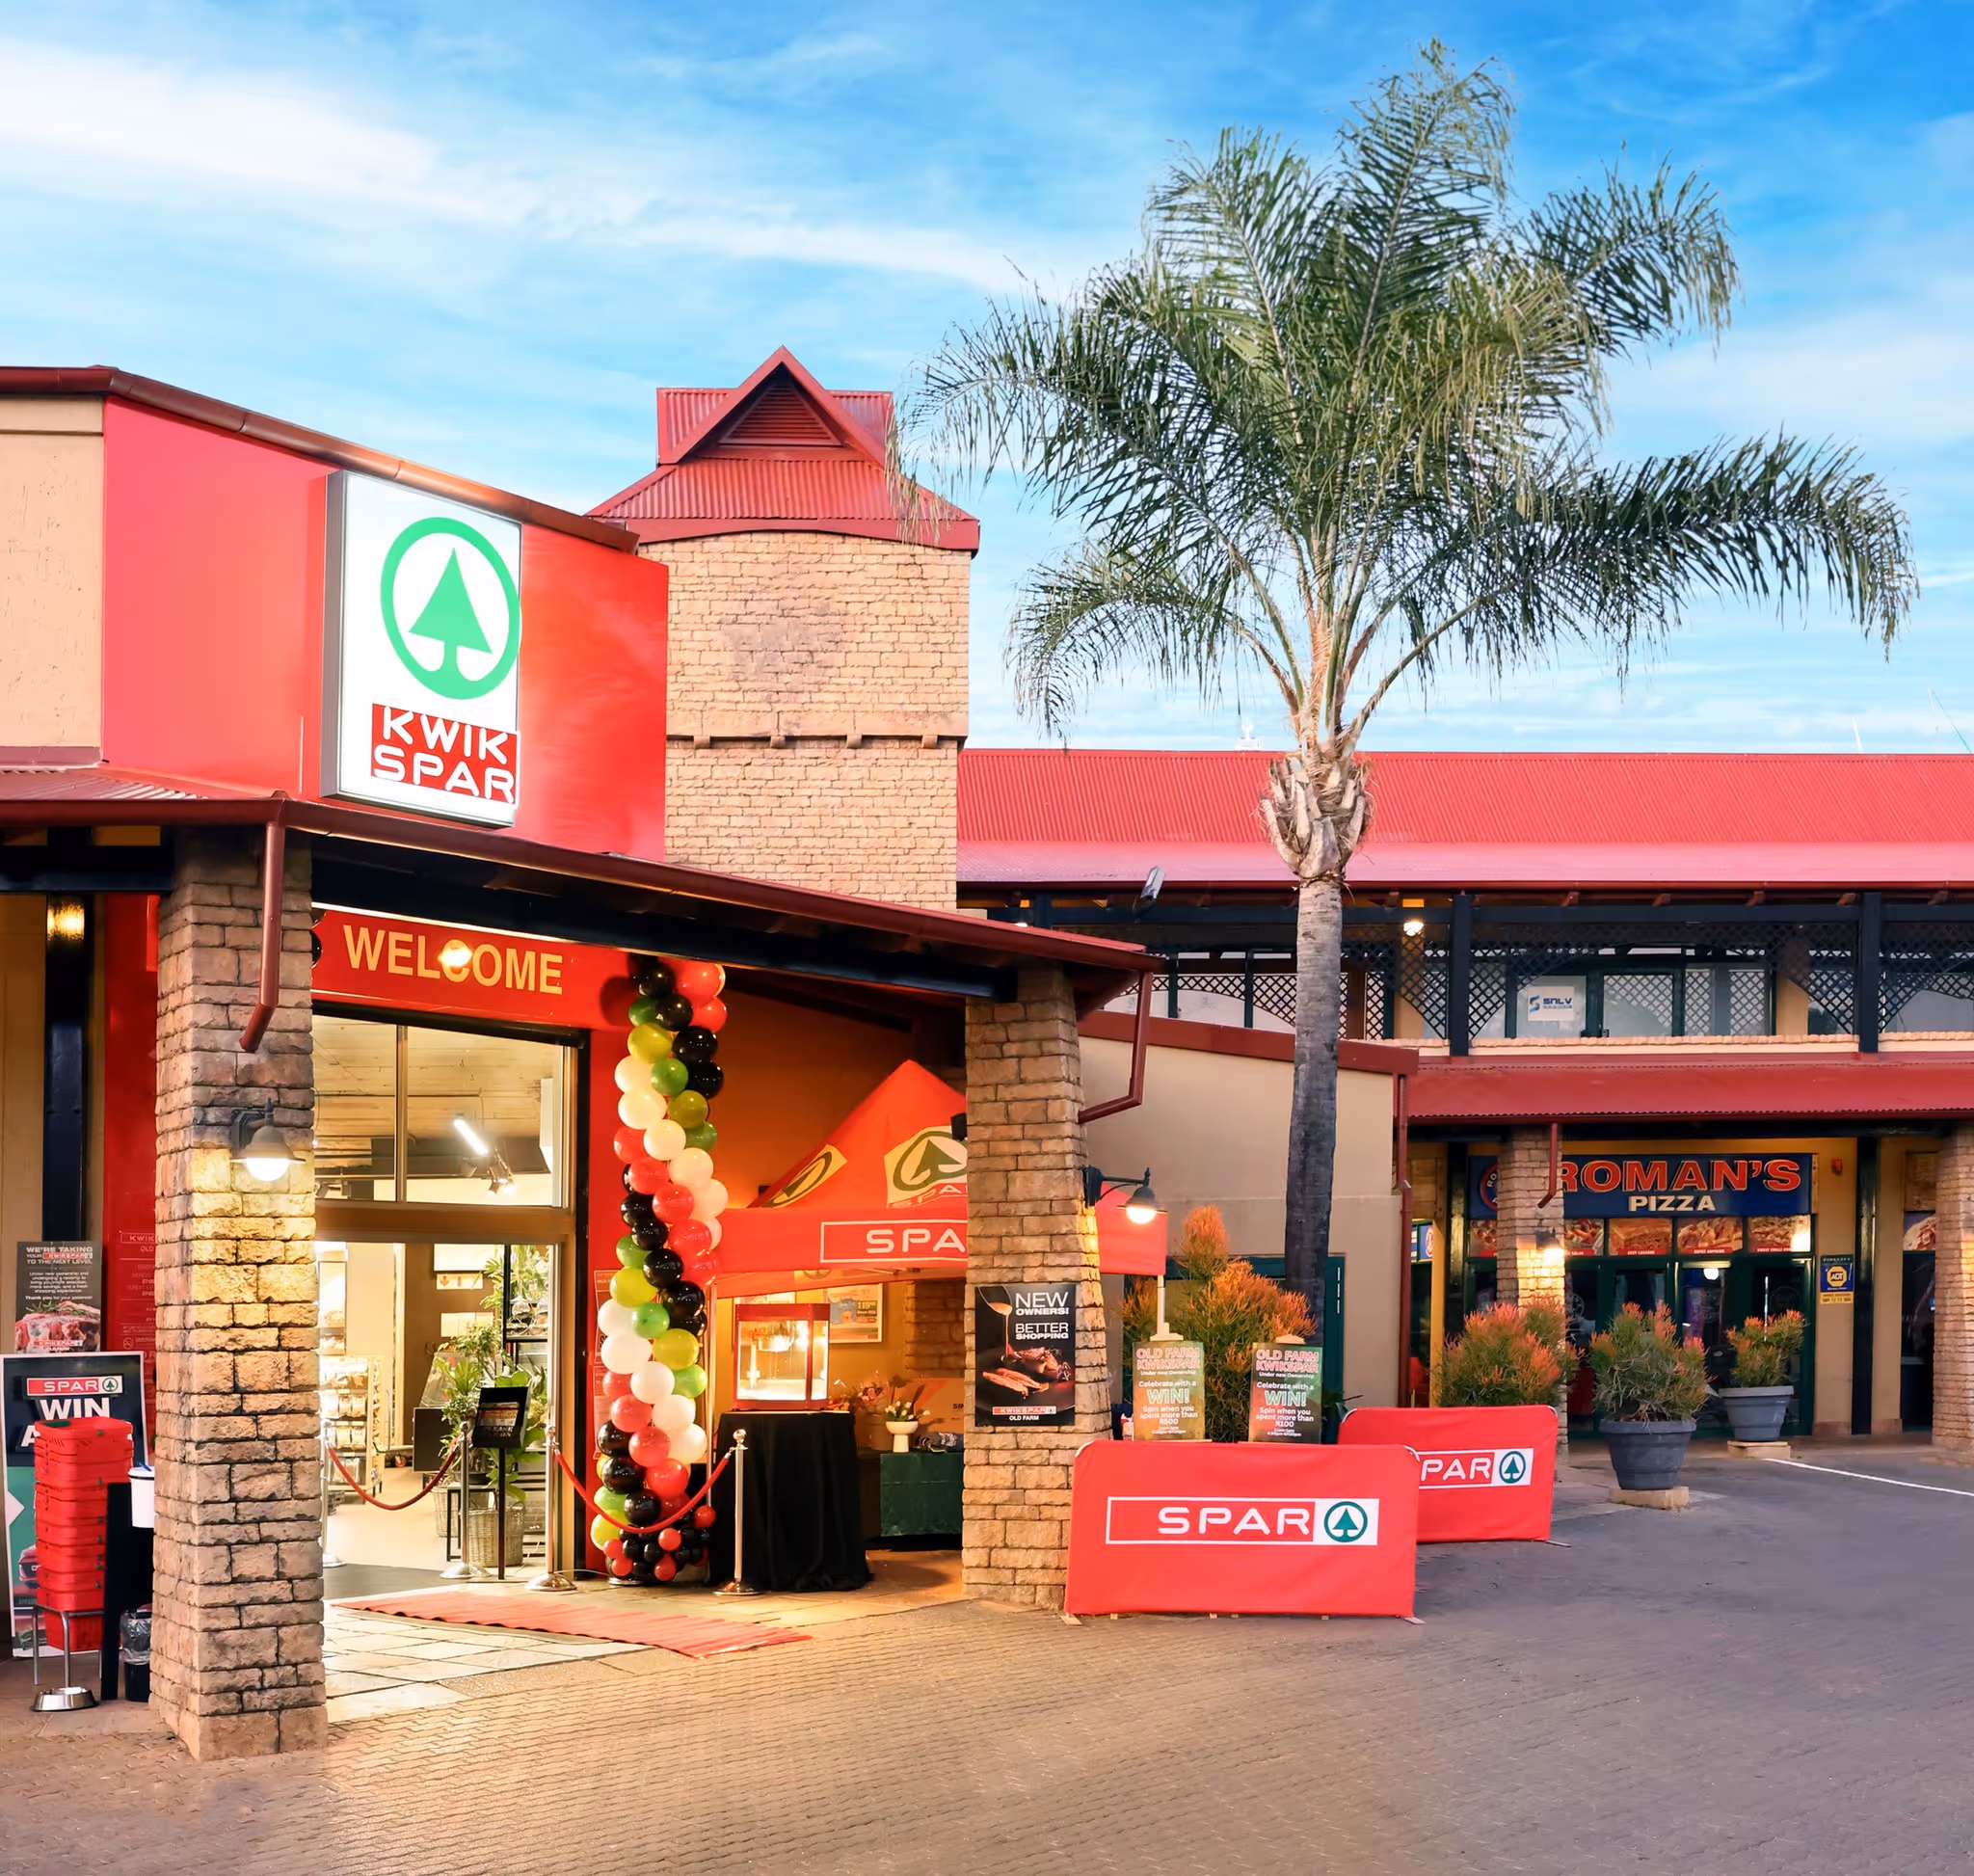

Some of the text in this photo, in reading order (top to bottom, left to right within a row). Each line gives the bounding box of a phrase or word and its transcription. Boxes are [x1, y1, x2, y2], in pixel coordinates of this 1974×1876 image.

[383, 706, 508, 764] KWIK
[373, 744, 515, 803] SPAR
[343, 925, 563, 995] WELCOME
[892, 1185, 968, 1209] SPA
[1628, 1195, 1716, 1212] PIZZA
[866, 1228, 966, 1253] SPA
[1015, 1292, 1069, 1308] NEW
[1015, 1307, 1069, 1316] OWNERS!
[1015, 1323, 1068, 1333] BETTER
[1136, 1347, 1200, 1359] OLD FARM
[1256, 1349, 1319, 1362] OLD FARM
[1136, 1358, 1200, 1370] KWIKSPAR
[1256, 1360, 1319, 1373] KWIKSPAR
[43, 1380, 98, 1392] SPAR
[1146, 1388, 1189, 1405] WIN!
[1264, 1390, 1307, 1407] WIN!
[40, 1398, 111, 1419] WIN
[1421, 1458, 1491, 1481] PAR
[1158, 1507, 1310, 1535] SPAR
